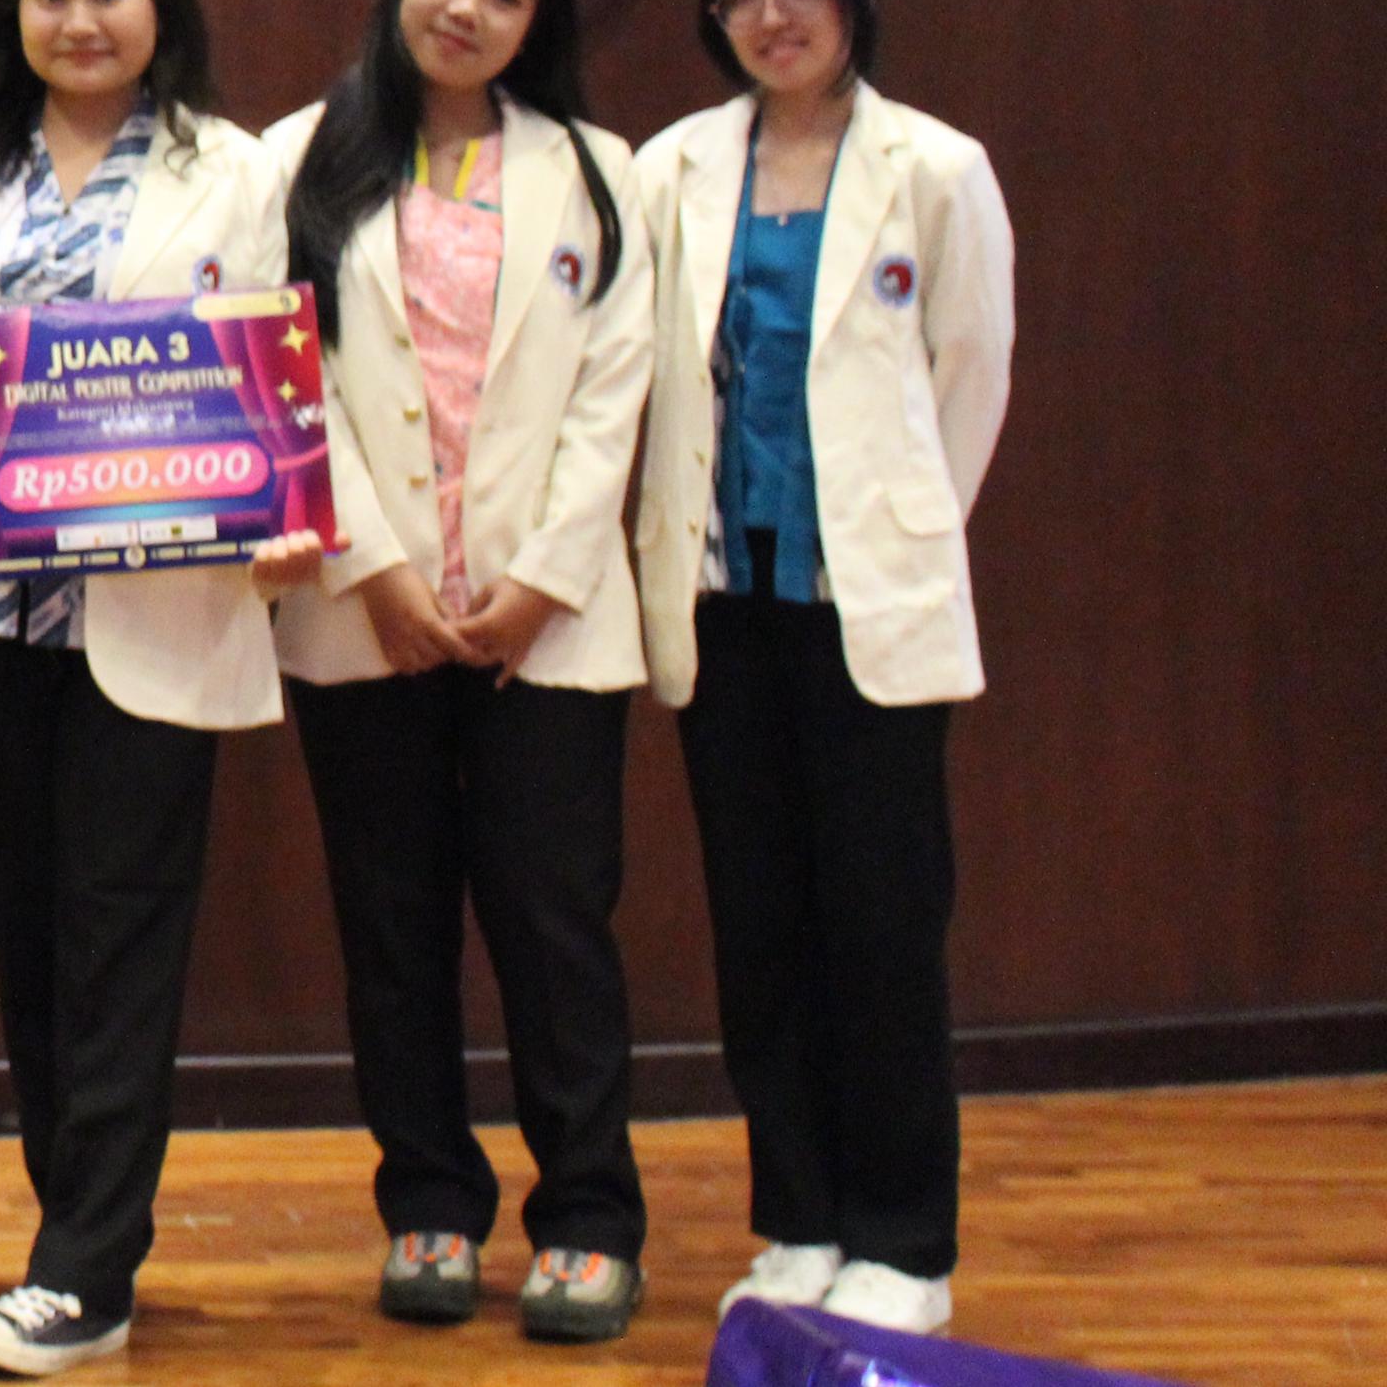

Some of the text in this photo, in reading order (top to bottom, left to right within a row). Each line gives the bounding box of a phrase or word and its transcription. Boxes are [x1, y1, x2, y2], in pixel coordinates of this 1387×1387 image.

[47, 331, 190, 378] JUARA 3
[12, 448, 252, 506] Rp500.000
